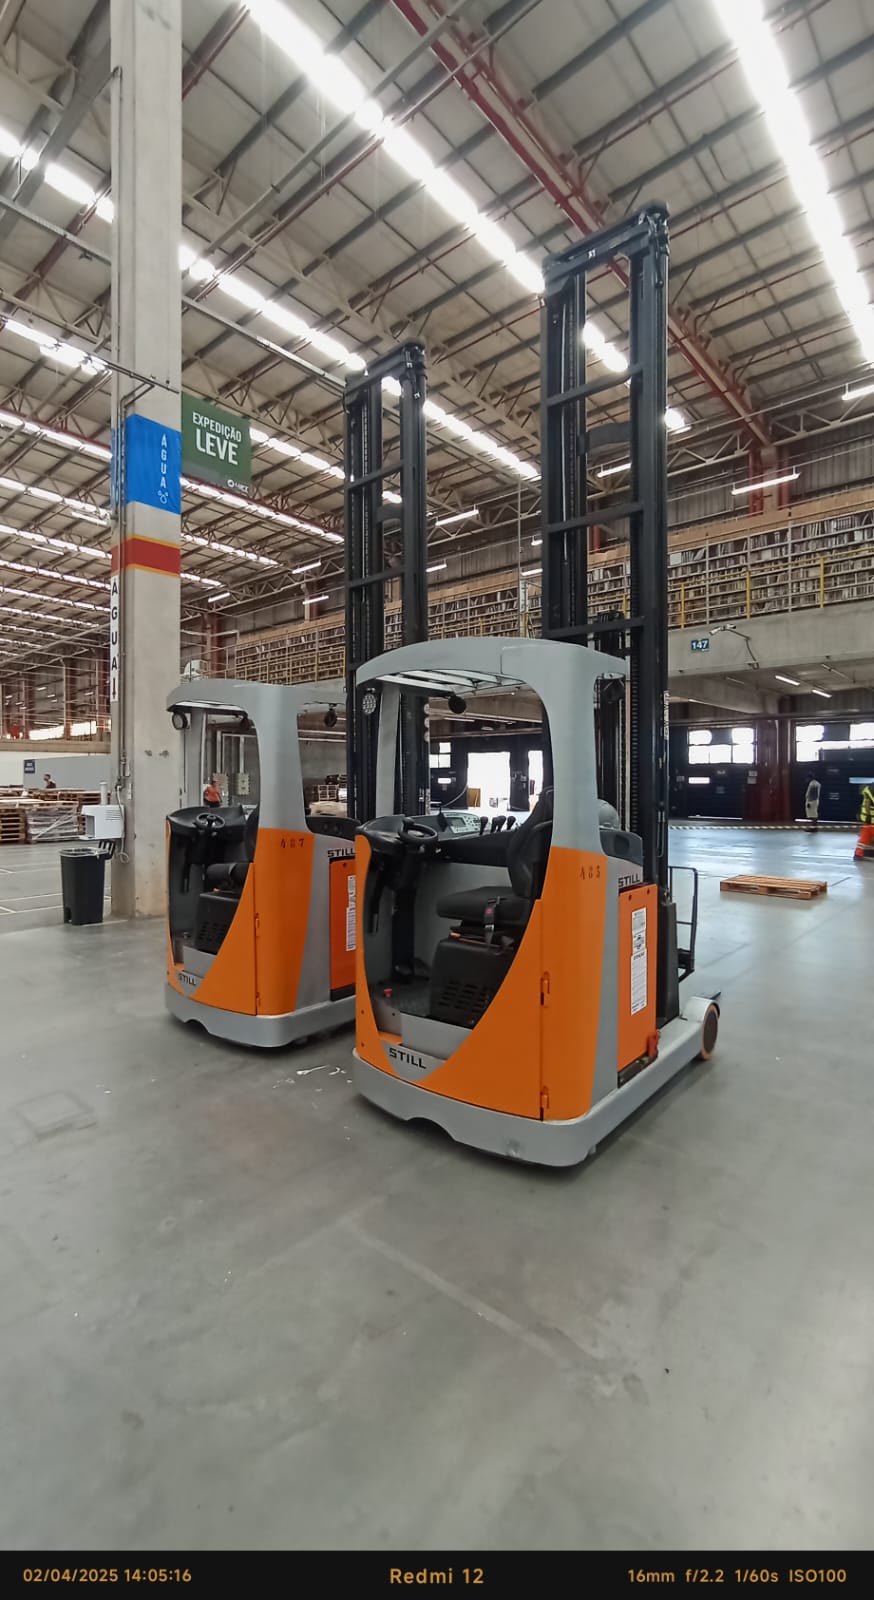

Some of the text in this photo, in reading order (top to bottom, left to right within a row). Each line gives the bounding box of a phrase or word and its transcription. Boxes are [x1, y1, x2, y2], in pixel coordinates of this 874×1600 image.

[192, 411, 242, 442] EXPEDIÇÃO
[196, 428, 239, 466] LEVE
[692, 640, 708, 650] 147
[327, 848, 356, 858] STILL
[618, 873, 640, 888] STILL
[178, 973, 196, 986] STILL
[389, 1047, 427, 1070] STILL
